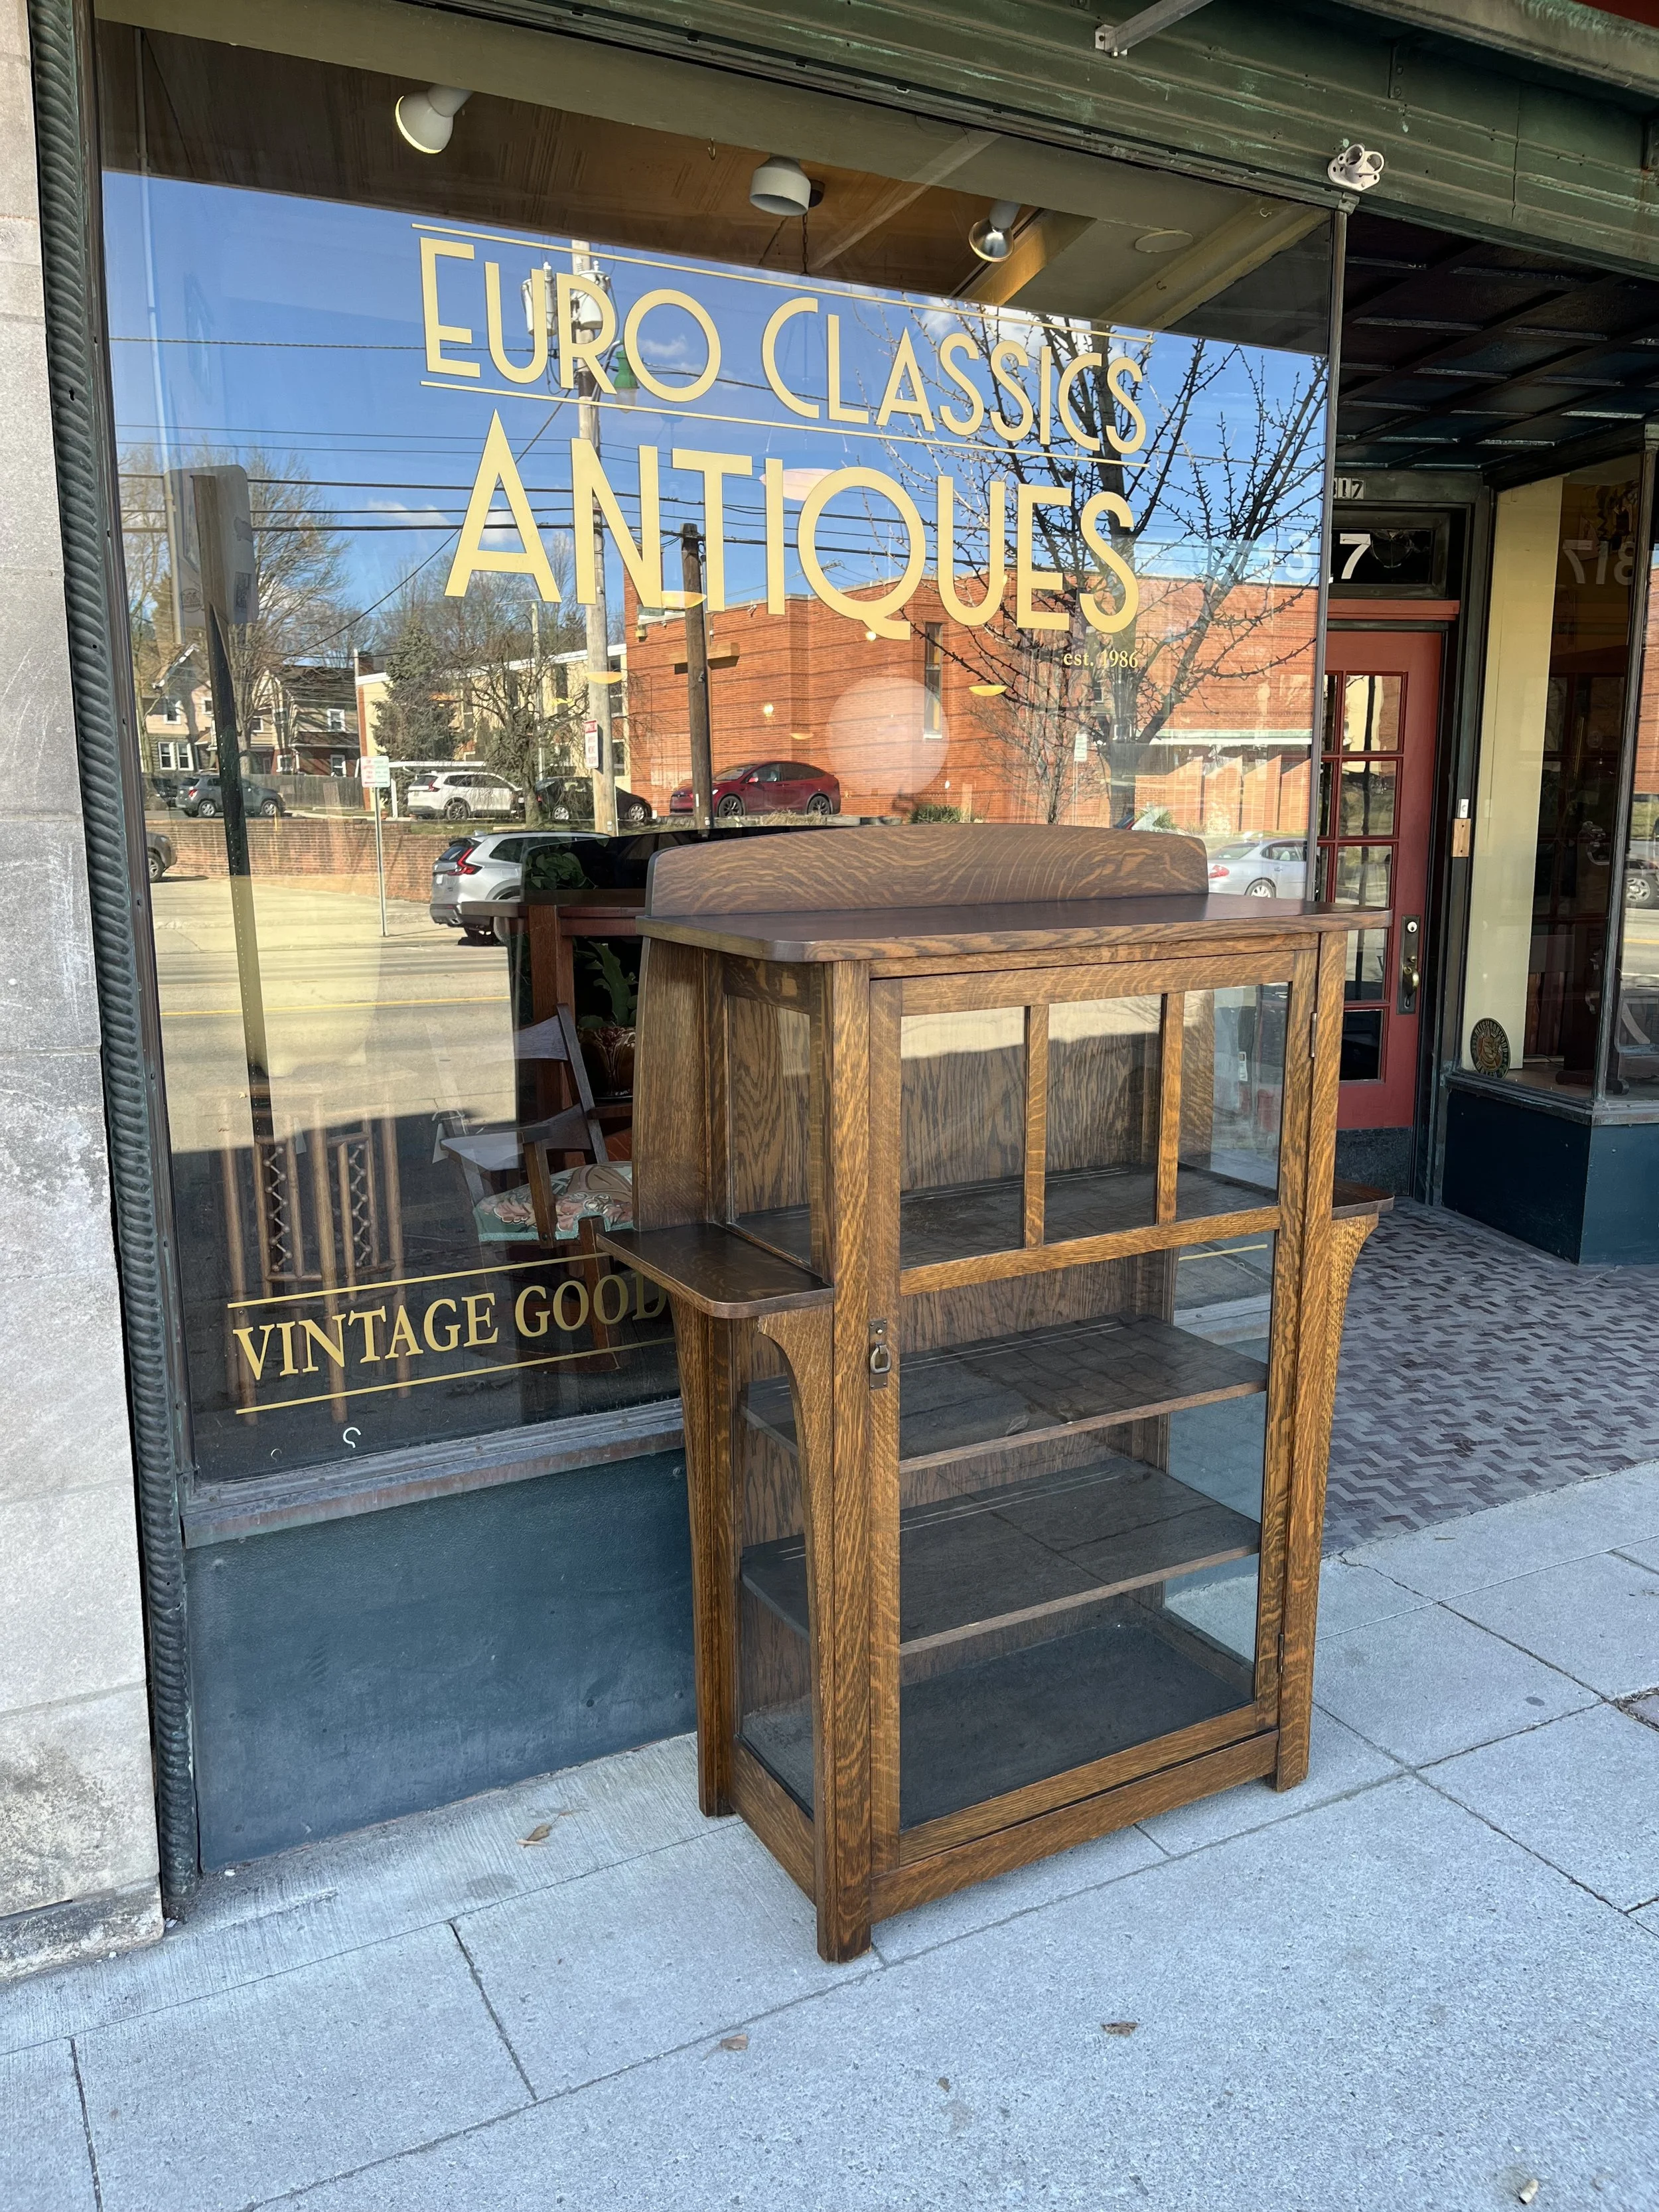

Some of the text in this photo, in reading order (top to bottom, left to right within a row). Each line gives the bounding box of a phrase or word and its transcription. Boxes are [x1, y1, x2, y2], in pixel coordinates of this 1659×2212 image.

[420, 237, 1147, 455] EURO CLASSICS
[444, 408, 1140, 640] ANTIQUES
[1333, 478, 1364, 499] 17
[1063, 650, 1139, 668] est. 1986
[233, 1292, 499, 1381] VINTAGE
